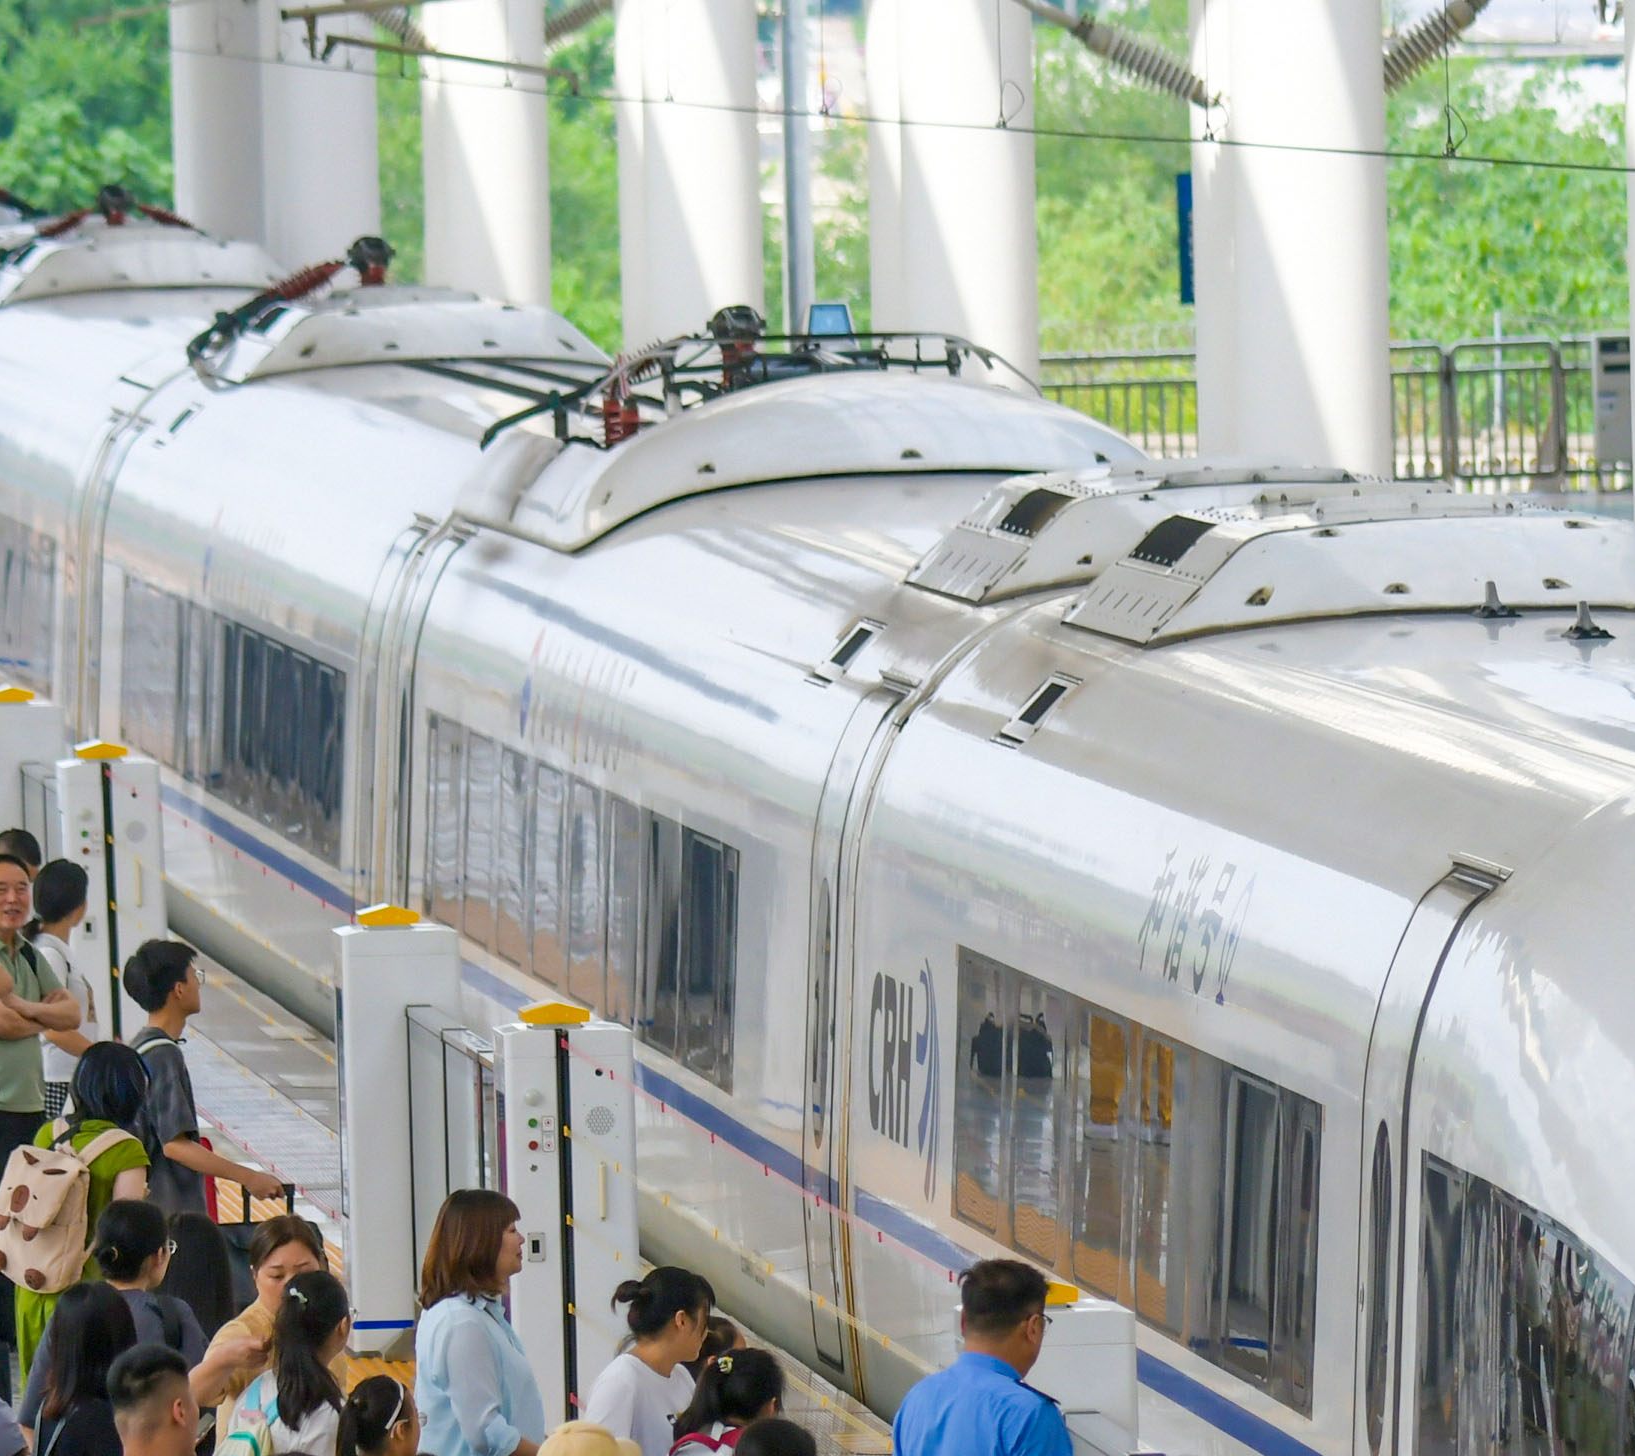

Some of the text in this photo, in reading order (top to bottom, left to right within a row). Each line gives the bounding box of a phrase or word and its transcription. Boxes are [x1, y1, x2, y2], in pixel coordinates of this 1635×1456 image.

[1138, 847, 1238, 994] 和谐号
[868, 971, 914, 1147] CRH
